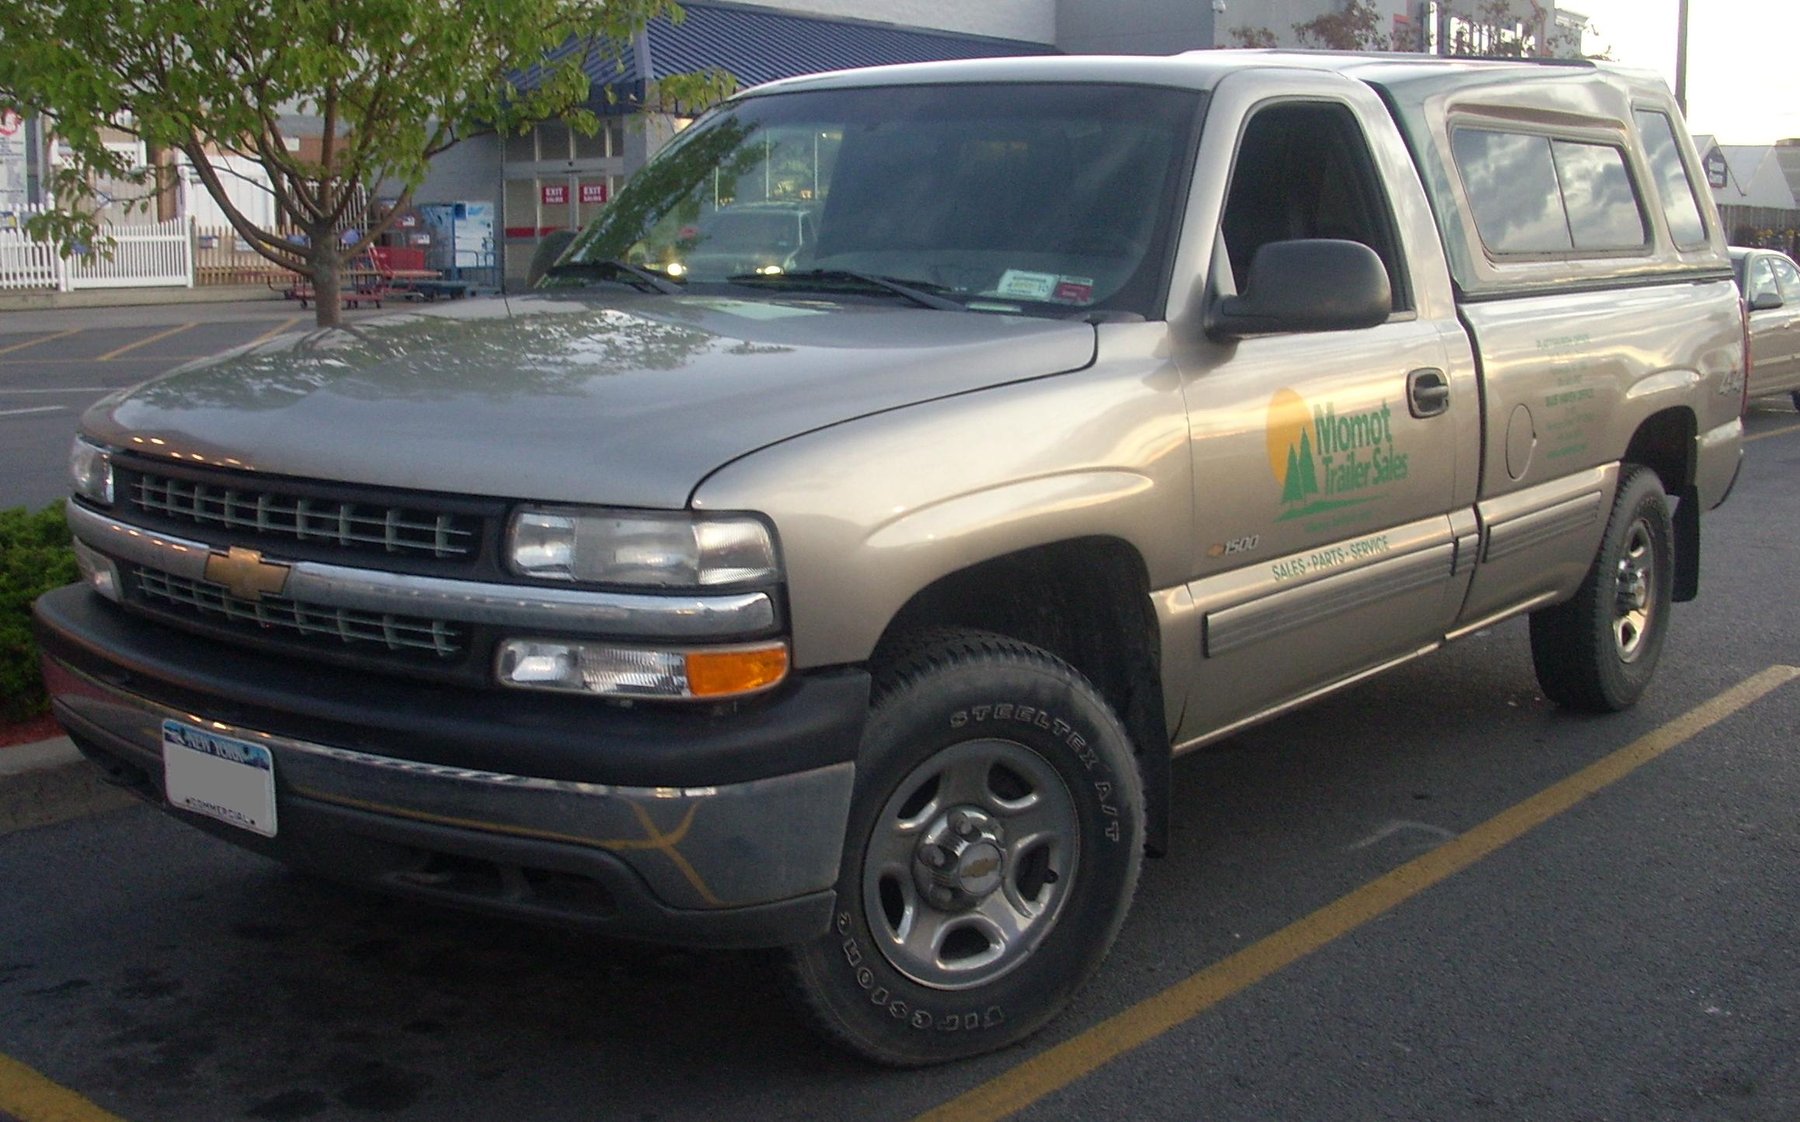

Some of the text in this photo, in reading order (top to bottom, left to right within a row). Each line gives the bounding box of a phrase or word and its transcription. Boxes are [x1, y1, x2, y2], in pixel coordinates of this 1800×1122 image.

[545, 187, 563, 196] EXIT
[584, 186, 601, 195] EXIT
[1314, 397, 1392, 455] Momot
[1322, 444, 1408, 496] Trailer Sales
[1223, 534, 1260, 556] 1500
[1271, 536, 1390, 581] SALES PARTS SERVICE
[950, 703, 1097, 771] STEELTEX
